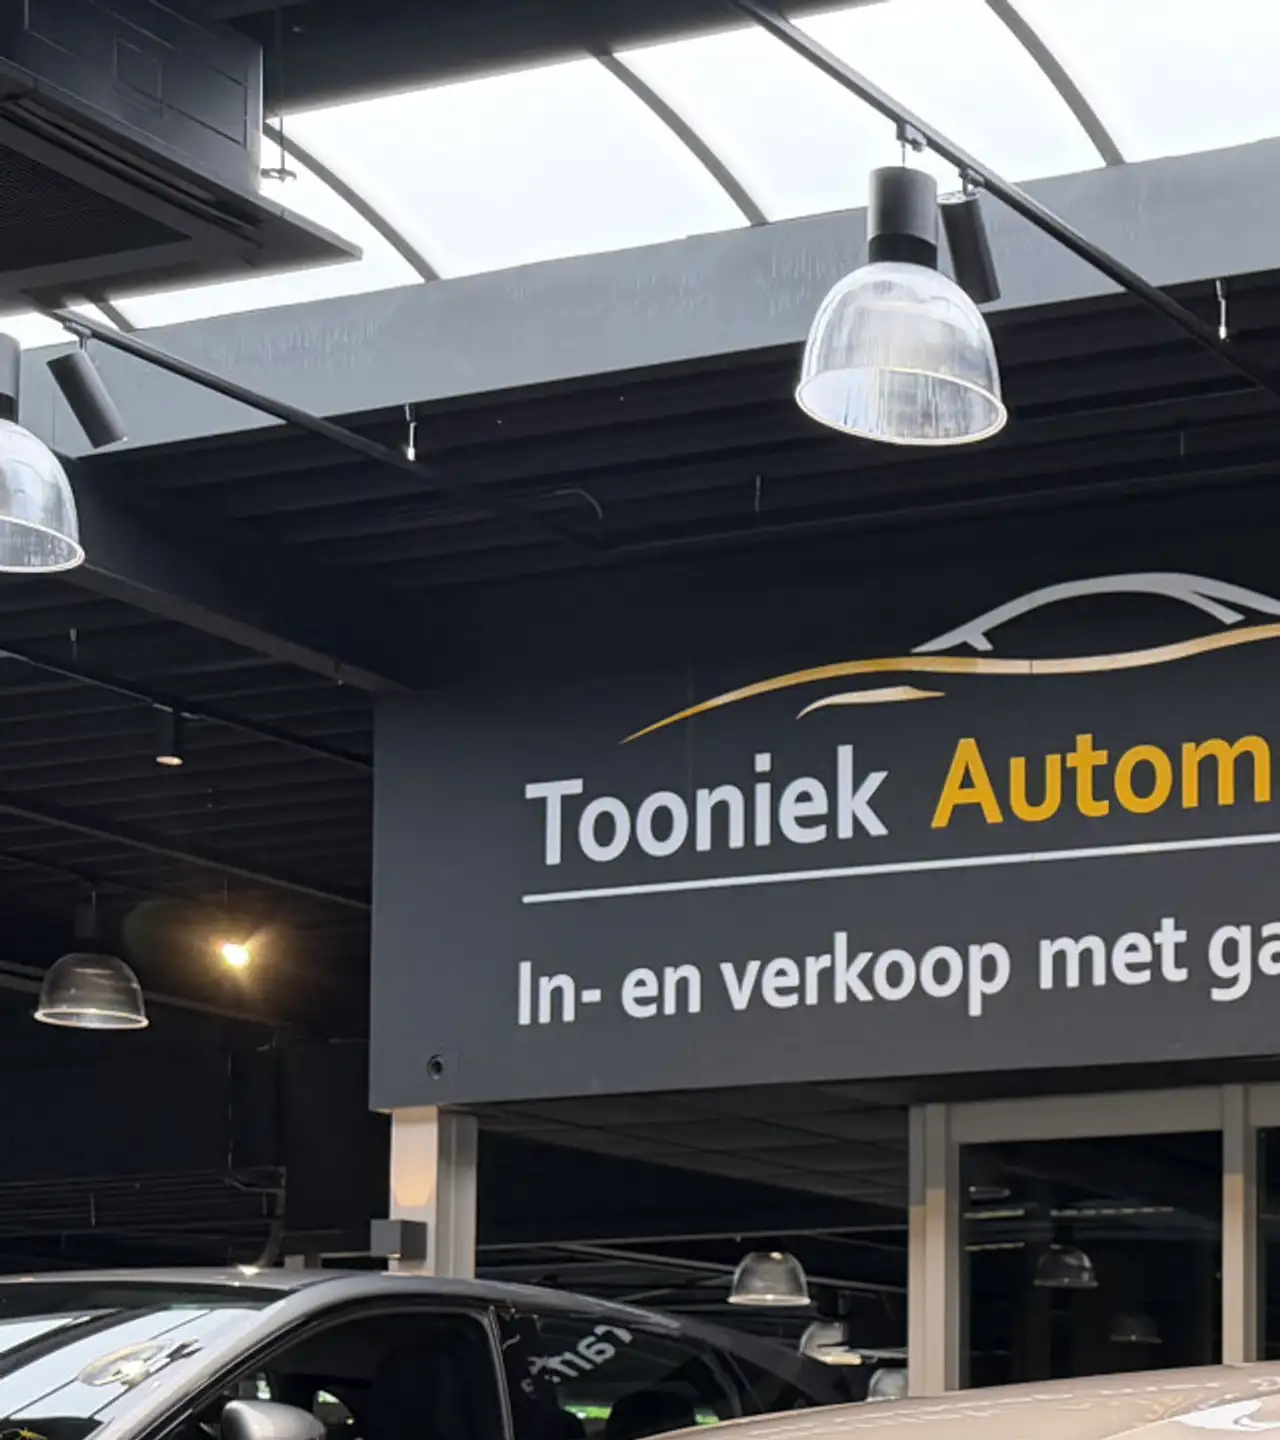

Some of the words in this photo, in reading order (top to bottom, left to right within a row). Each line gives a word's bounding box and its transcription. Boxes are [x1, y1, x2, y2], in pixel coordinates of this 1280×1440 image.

[525, 744, 889, 866] Tooniek
[518, 960, 602, 1026] In-
[621, 964, 701, 1019] en
[719, 931, 1011, 1017] verkoop
[1039, 917, 1188, 990] met
